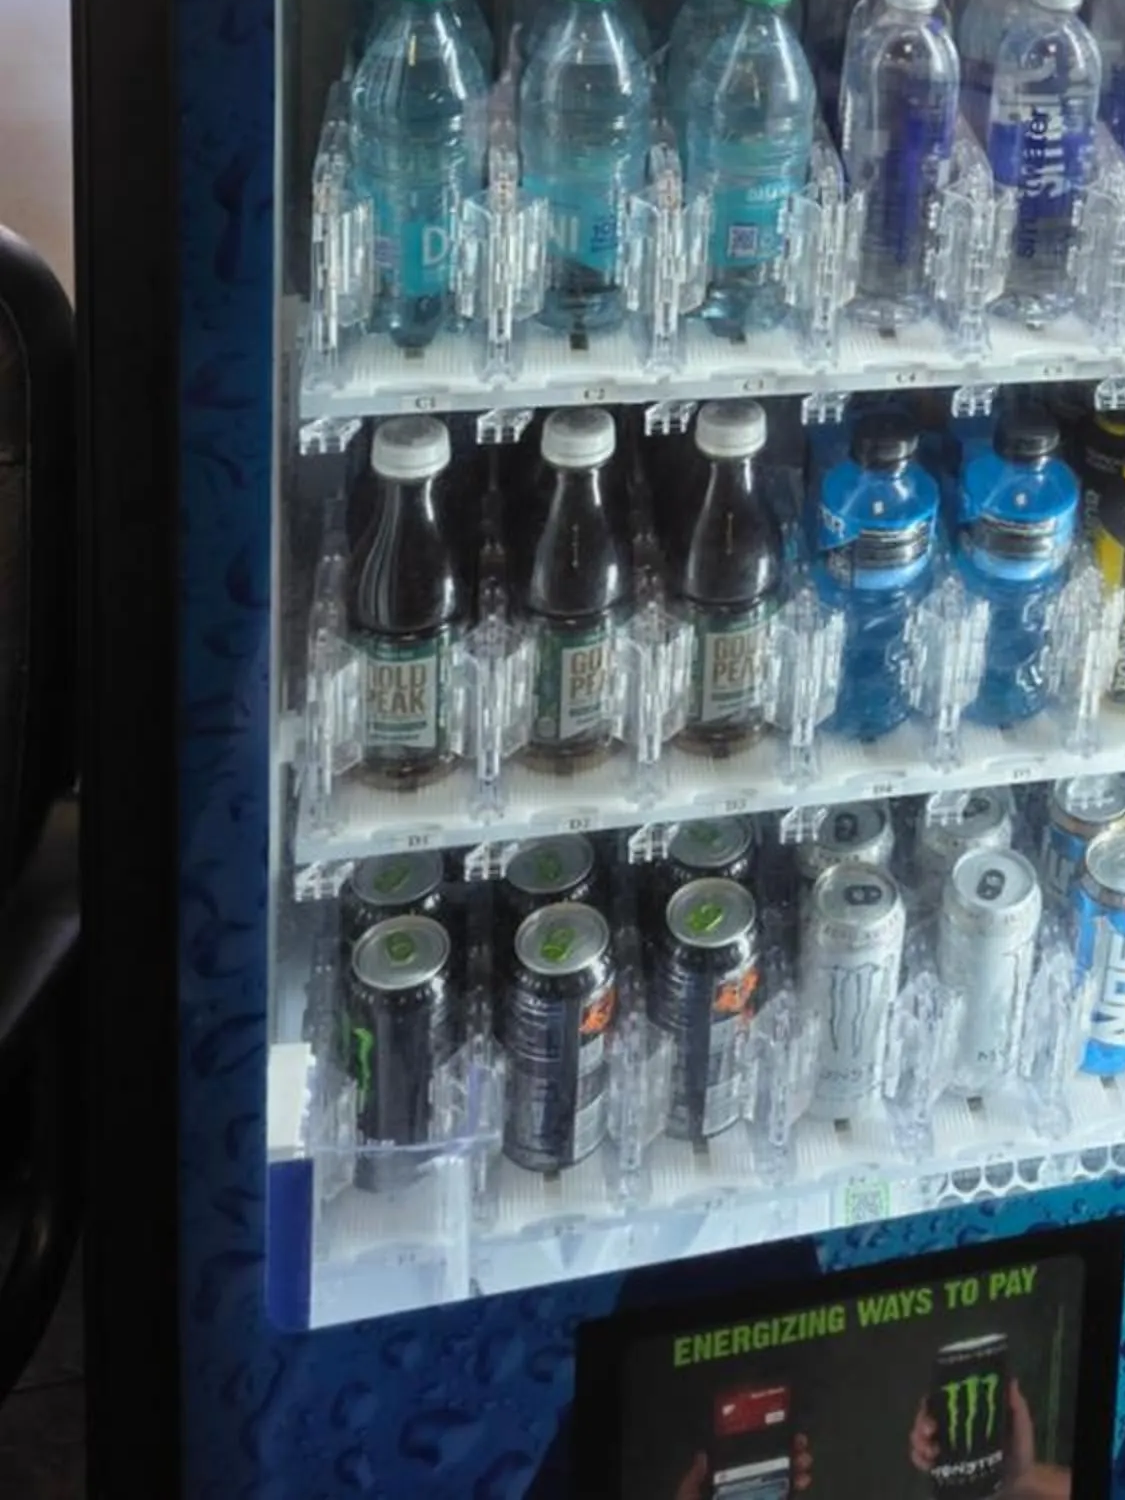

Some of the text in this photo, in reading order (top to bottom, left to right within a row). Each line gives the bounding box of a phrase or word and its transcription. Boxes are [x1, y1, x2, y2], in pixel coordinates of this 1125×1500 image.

[896, 373, 916, 383] C4
[584, 389, 605, 399] C2
[416, 398, 436, 409] C1
[569, 819, 590, 830] D2
[409, 835, 429, 847] D1
[673, 1265, 1038, 1366] ENERGIZING WAYS TO PAY
